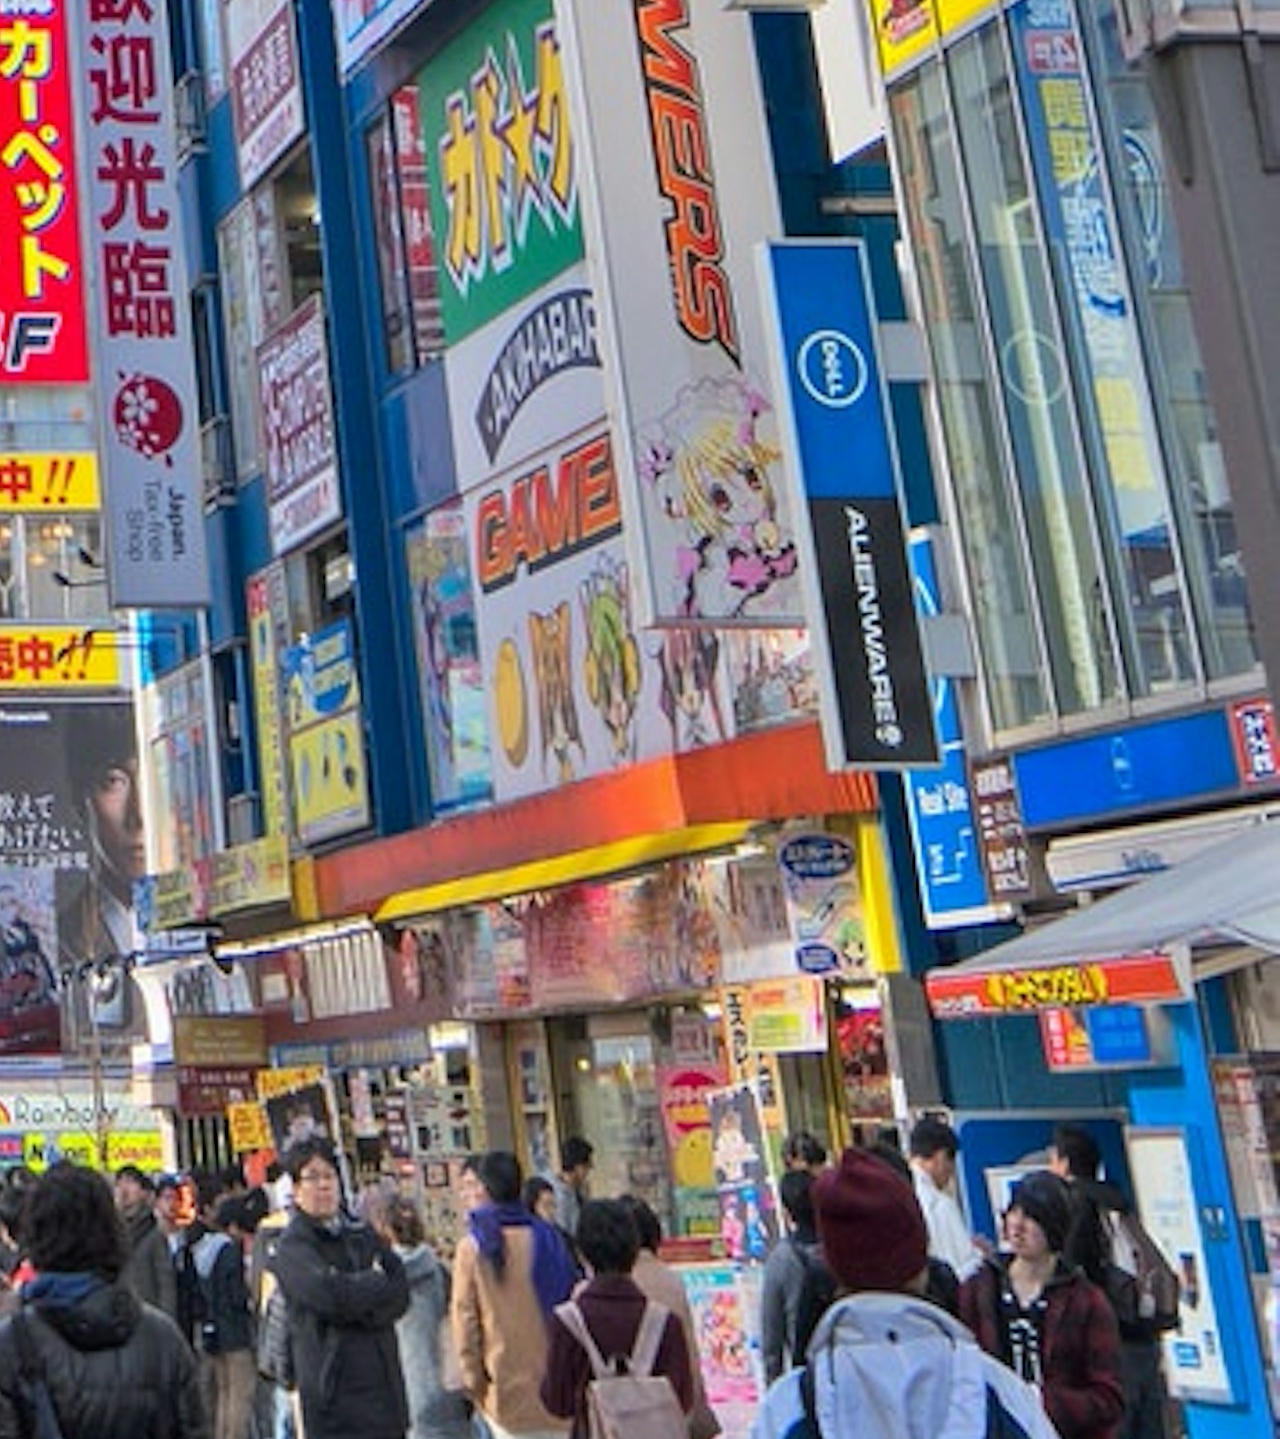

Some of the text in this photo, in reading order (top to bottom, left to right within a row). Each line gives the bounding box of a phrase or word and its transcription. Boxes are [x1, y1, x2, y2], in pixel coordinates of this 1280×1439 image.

[818, 338, 845, 398] DELL
[473, 431, 625, 595] GAME
[843, 504, 898, 726] ALIENWARE
